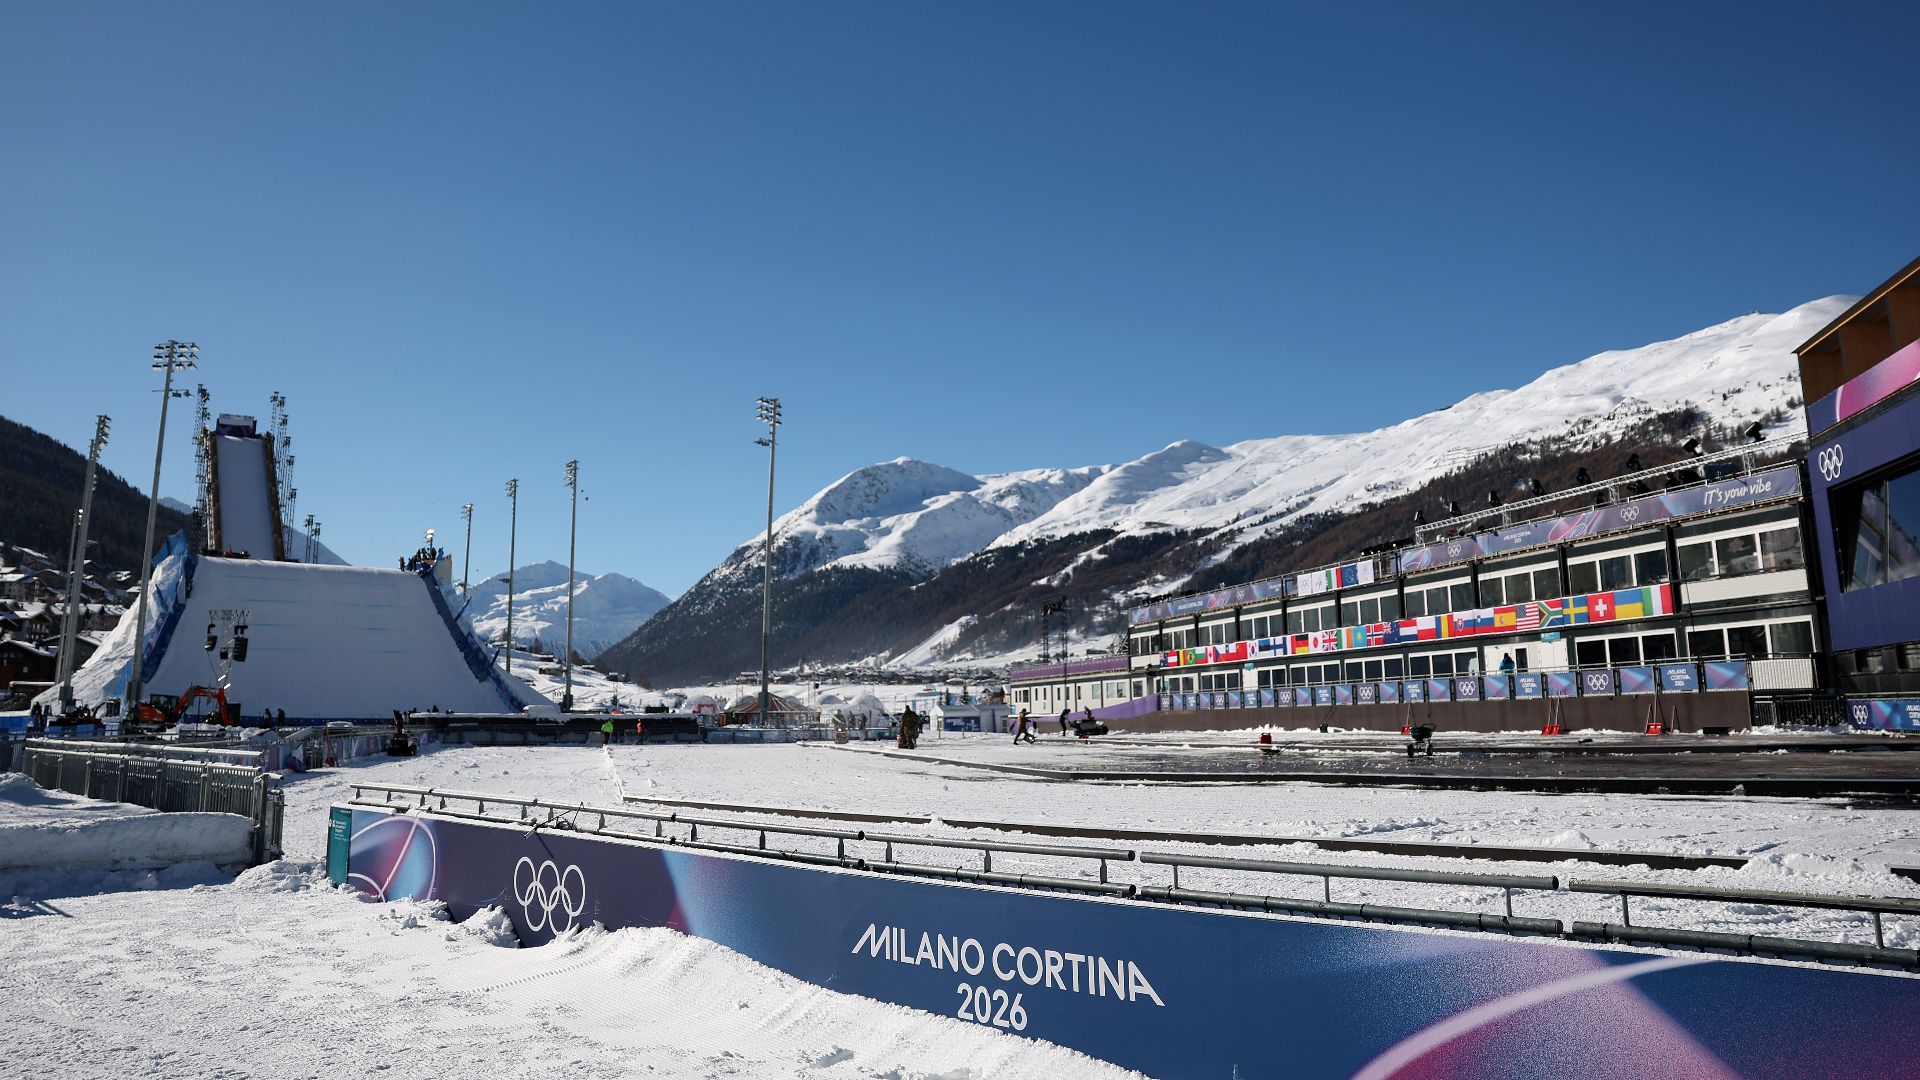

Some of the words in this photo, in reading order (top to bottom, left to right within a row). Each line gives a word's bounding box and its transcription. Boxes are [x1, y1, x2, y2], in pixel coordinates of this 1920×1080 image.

[1724, 486, 1749, 504] your
[1749, 478, 1772, 495] vibe
[852, 923, 985, 975] MILANO
[992, 943, 1165, 1006] CORTINA
[957, 983, 1028, 1031] 2026
